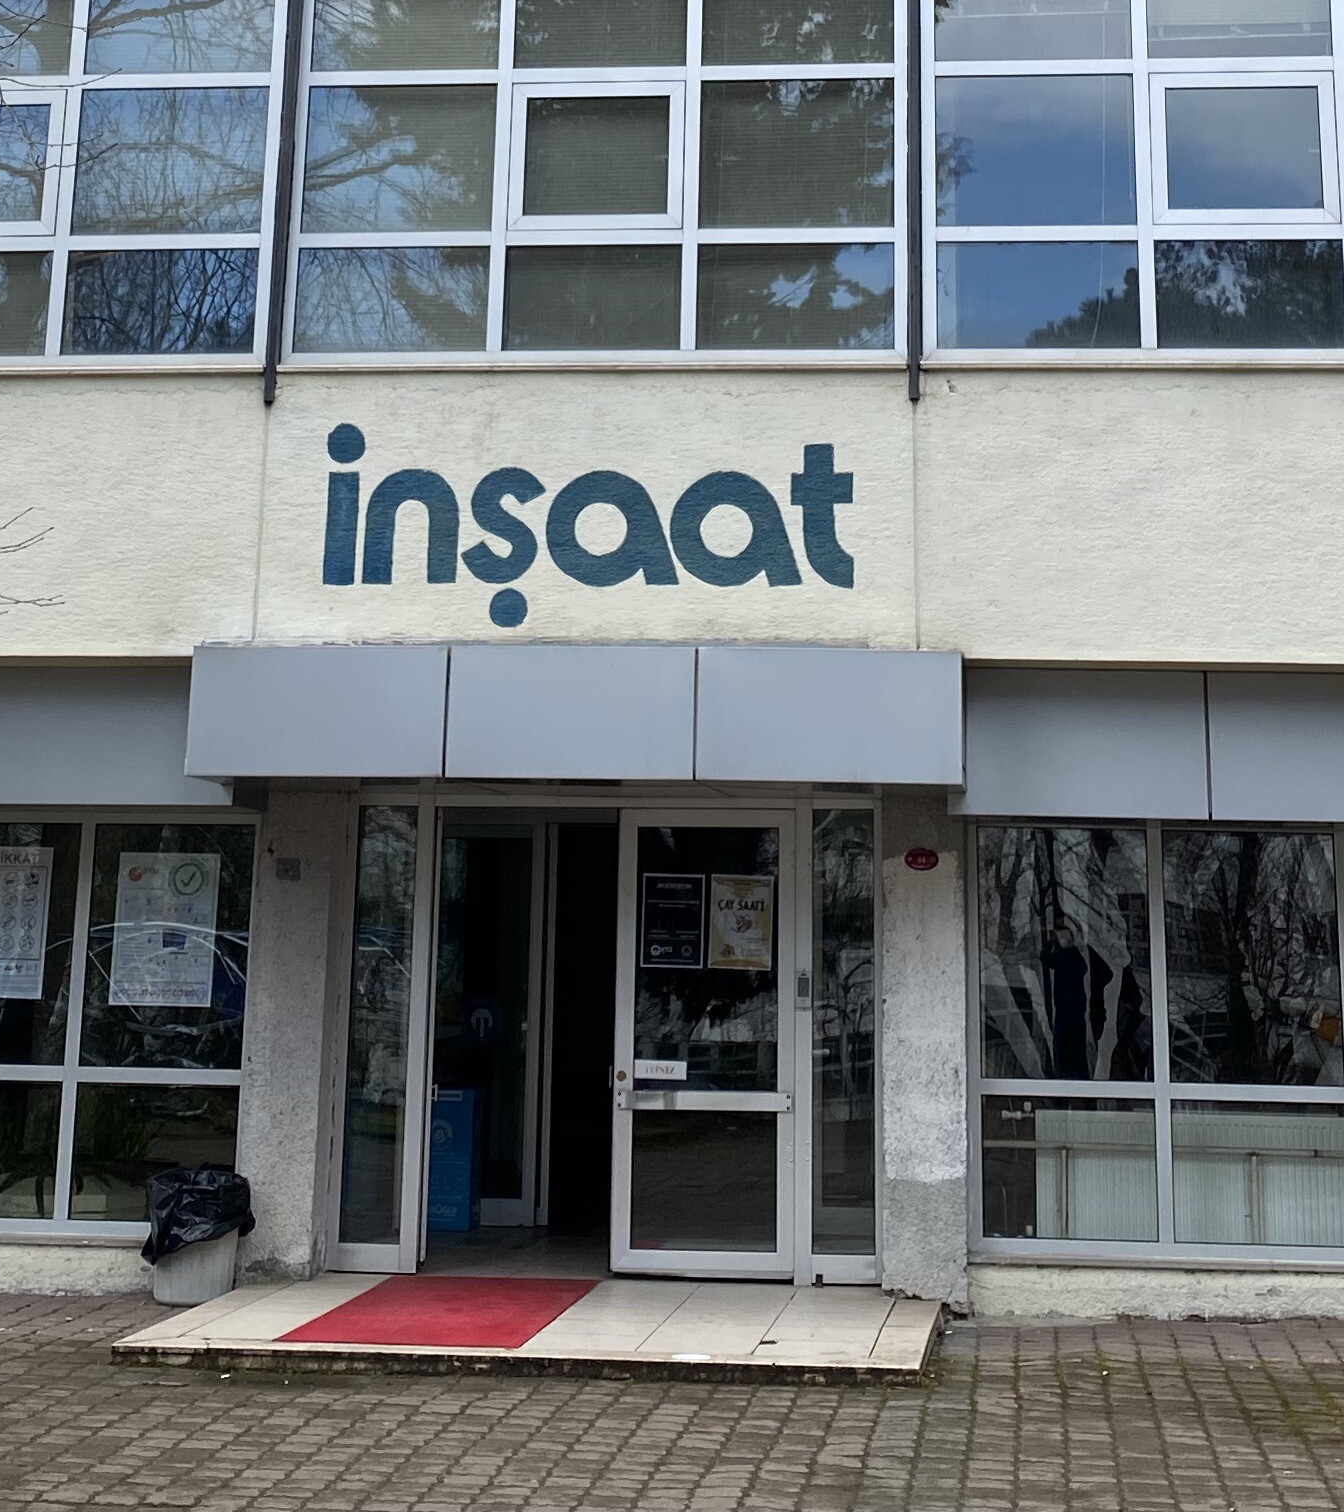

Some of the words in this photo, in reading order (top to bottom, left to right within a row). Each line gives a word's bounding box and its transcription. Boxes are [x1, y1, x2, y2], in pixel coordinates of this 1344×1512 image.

[322, 422, 855, 628] inşaat
[717, 898, 735, 912] ÇAY
[737, 898, 766, 913] SAATİ
